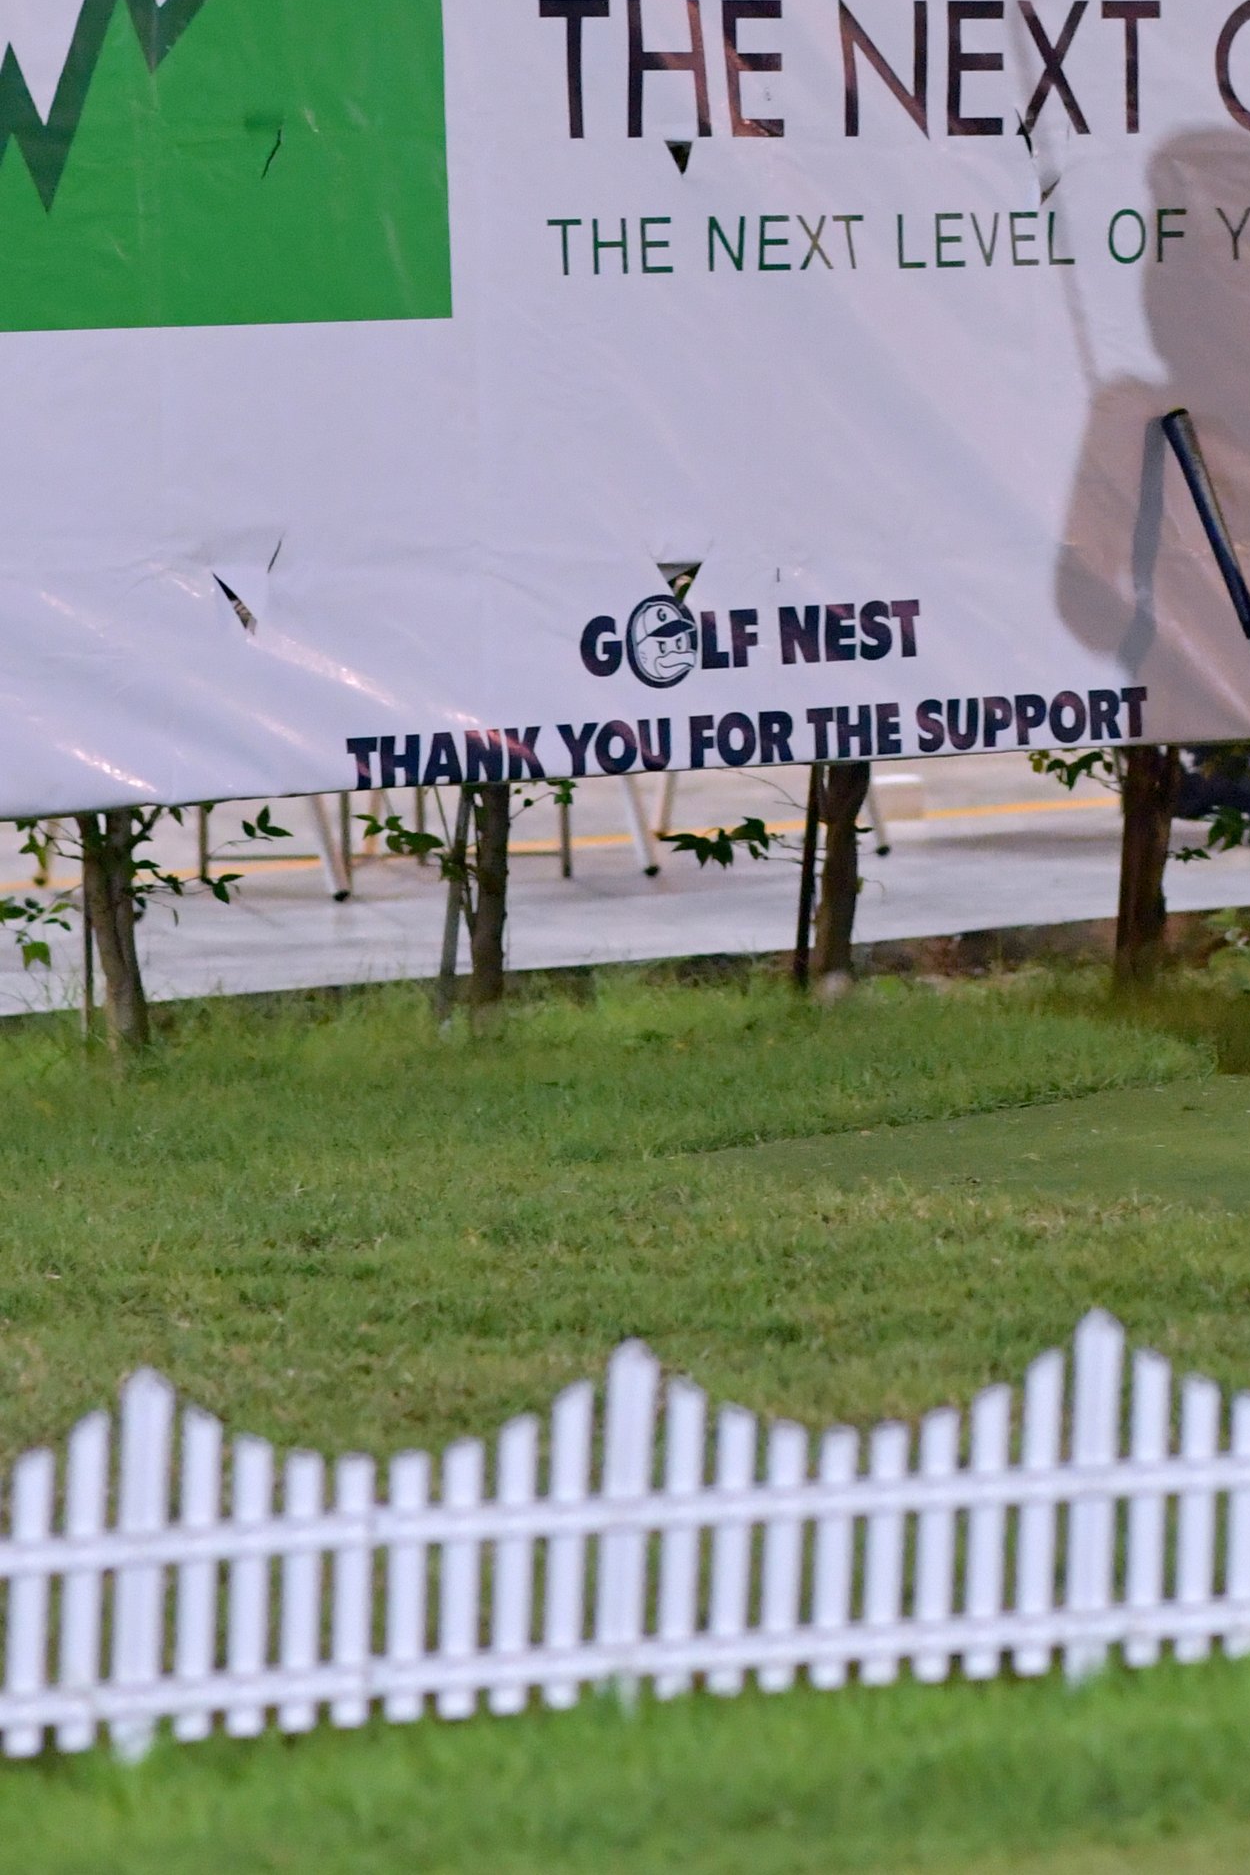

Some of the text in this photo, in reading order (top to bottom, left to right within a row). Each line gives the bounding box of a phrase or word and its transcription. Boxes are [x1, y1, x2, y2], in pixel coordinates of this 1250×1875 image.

[547, 216, 674, 276] THE
[707, 214, 864, 273] NEXT
[897, 210, 1076, 271] LEVEL
[1108, 208, 1187, 264] OF
[778, 599, 920, 665] NEST
[346, 685, 1148, 791] THANK YOU FOR THE SUPPORT
